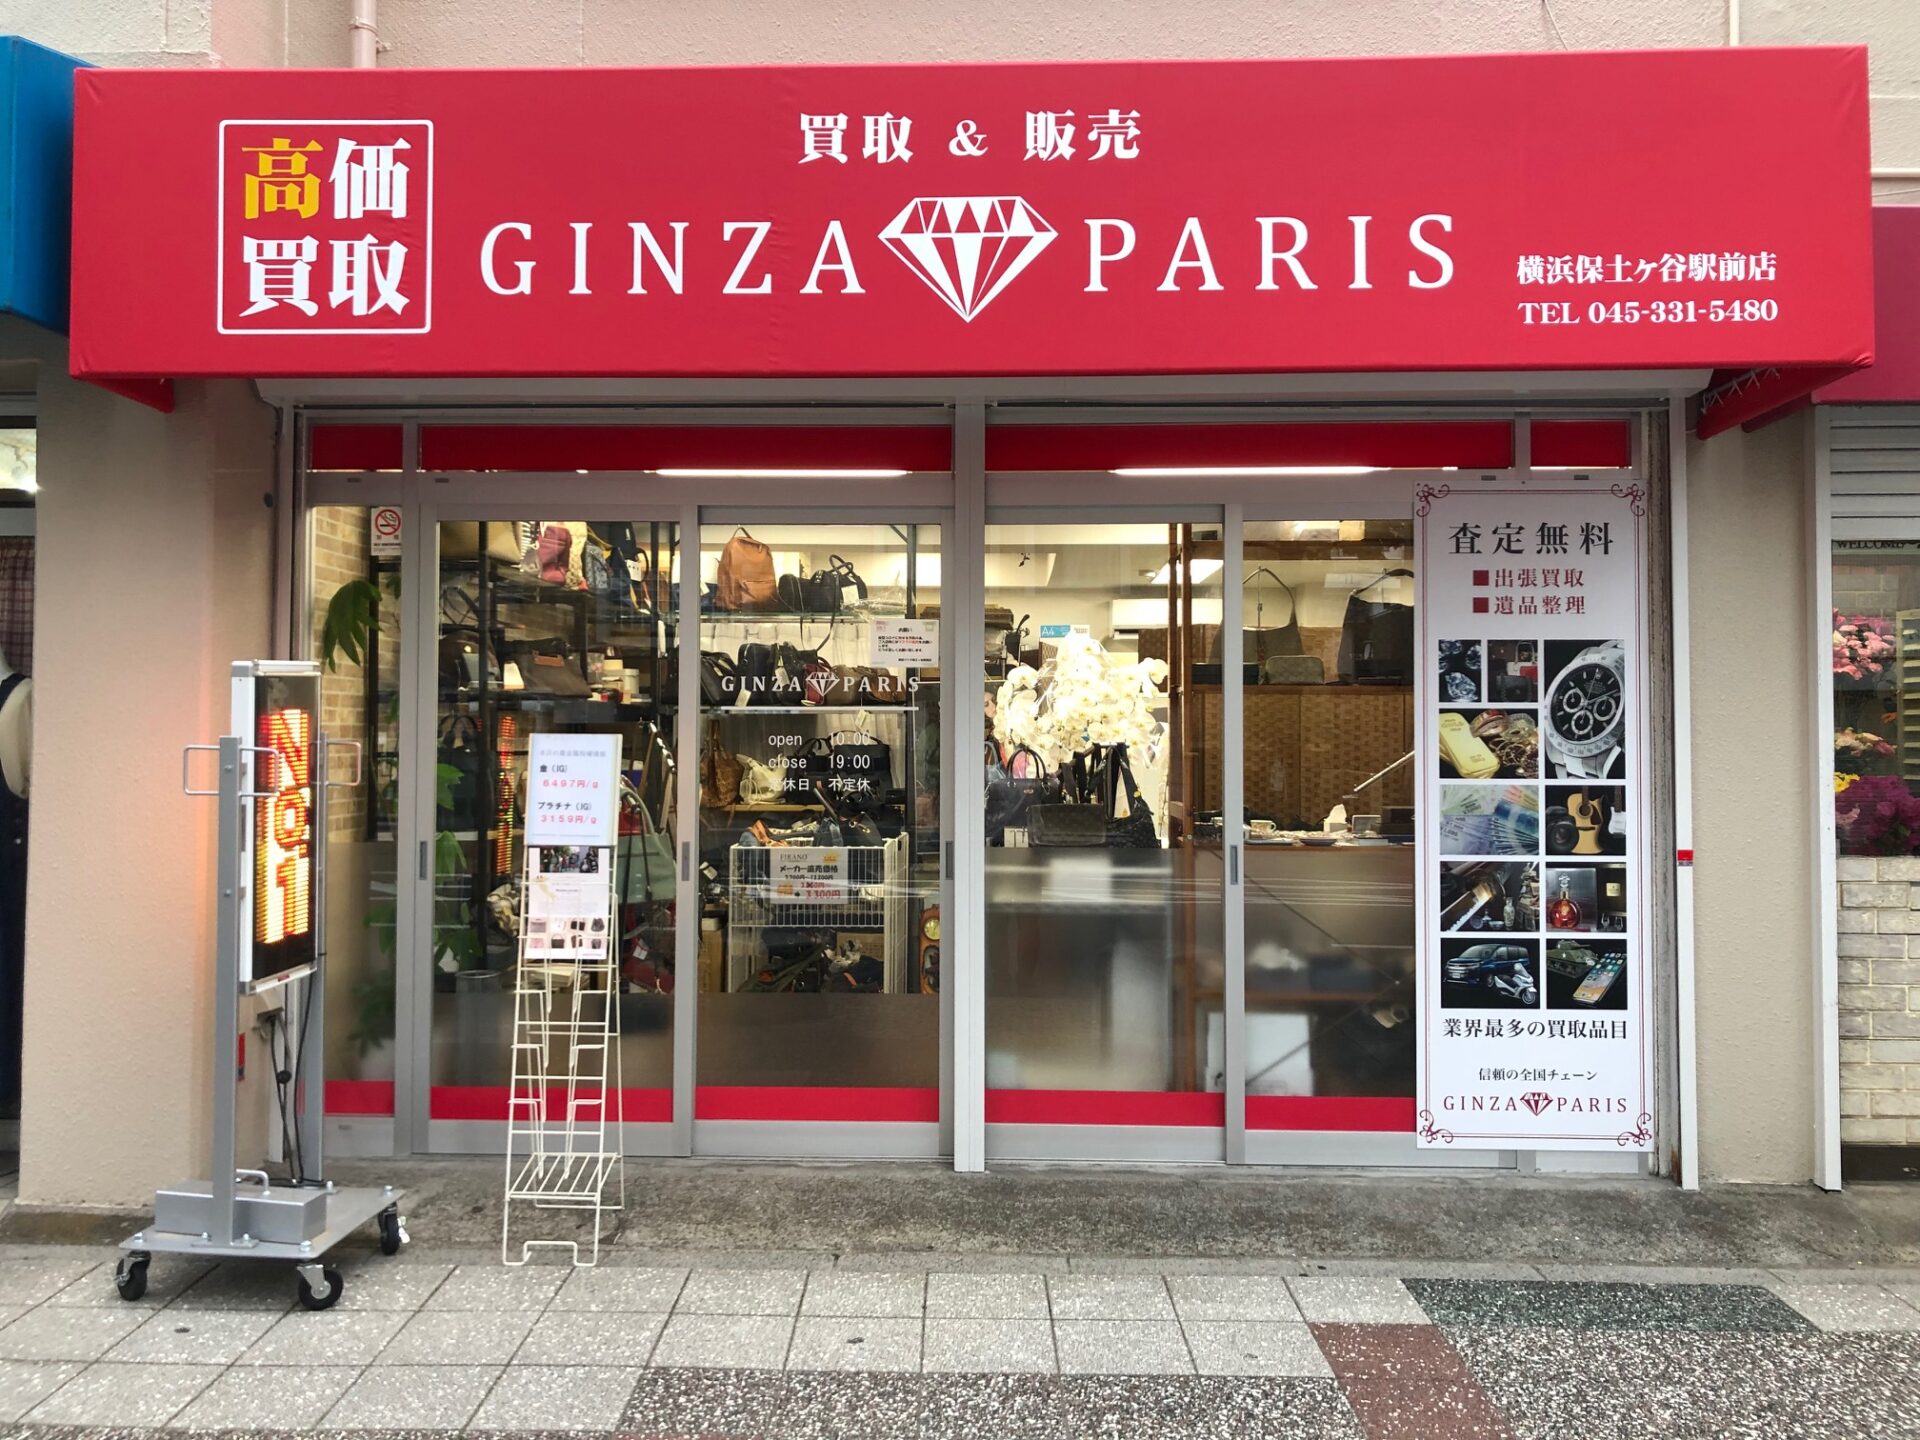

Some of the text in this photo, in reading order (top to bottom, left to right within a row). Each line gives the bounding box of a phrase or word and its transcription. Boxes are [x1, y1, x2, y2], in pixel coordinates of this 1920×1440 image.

[798, 108, 1142, 165] 買取 & 販売
[241, 137, 411, 220] 高価
[479, 213, 1455, 297] GINZA PARIS
[239, 233, 410, 317] 買取
[1516, 251, 1778, 285] 横浜保土ヶ谷駅前店
[1517, 298, 1779, 325] TEL 045-331-5480
[1448, 521, 1614, 556] 査定無料
[1493, 567, 1585, 588] 出張買取
[1493, 595, 1586, 616] 遺品整理
[721, 675, 920, 693] GINZA PARIS
[768, 731, 870, 748] open 10:00
[768, 752, 871, 769] close 19:00
[827, 777, 871, 792] 不定休
[1442, 1017, 1628, 1040] 業界最多の買取品目
[1478, 1067, 1598, 1082] 信頼の全国チェーン
[1443, 1095, 1627, 1113] GINZA PARIS
